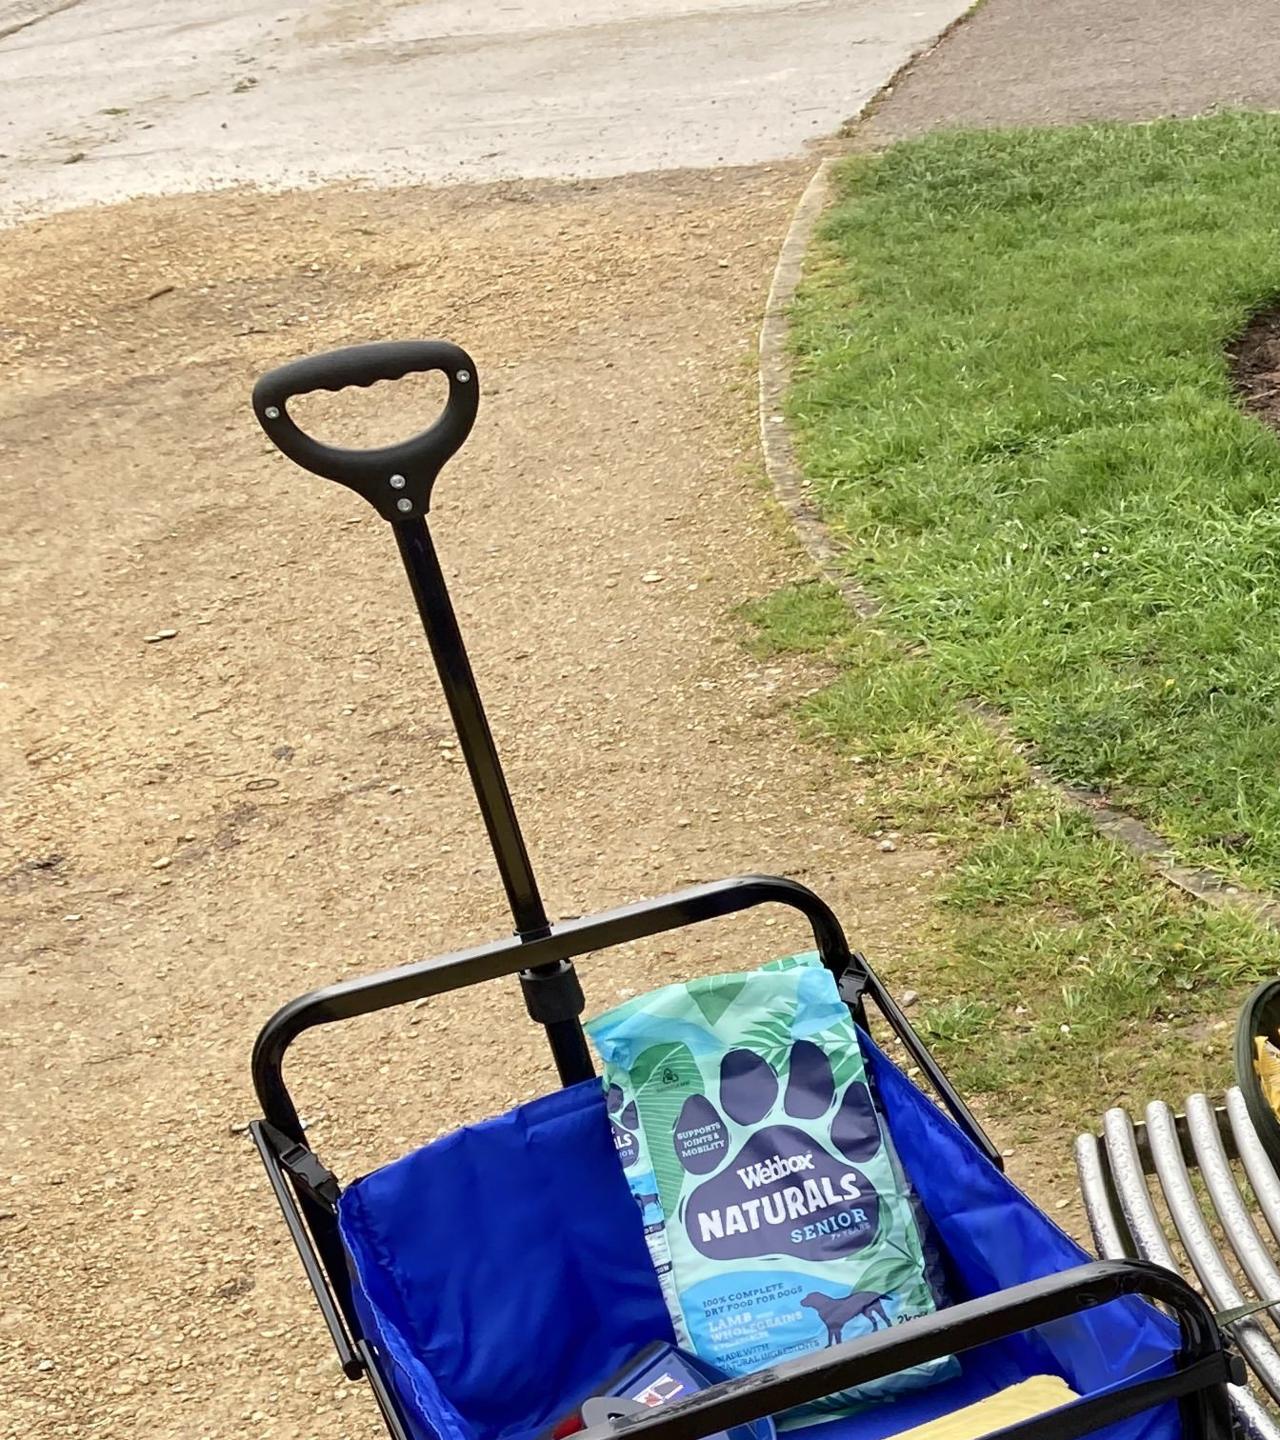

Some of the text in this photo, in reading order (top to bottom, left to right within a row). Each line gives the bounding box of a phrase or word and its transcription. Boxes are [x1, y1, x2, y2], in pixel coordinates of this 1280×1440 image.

[677, 1122, 721, 1140] SUPPORTS
[684, 1134, 712, 1149] JOINTS
[682, 1139, 725, 1158] MOBILITY
[736, 1154, 815, 1190] Webbox
[698, 1173, 862, 1243] NATURALS
[791, 1208, 868, 1243] SENIOR
[702, 1282, 784, 1308] 100% COMPLETE
[704, 1285, 803, 1318] DRY FOOD FOR DOGS
[708, 1312, 753, 1332] LAMB
[711, 1310, 804, 1341] WHOLEGRAINS
